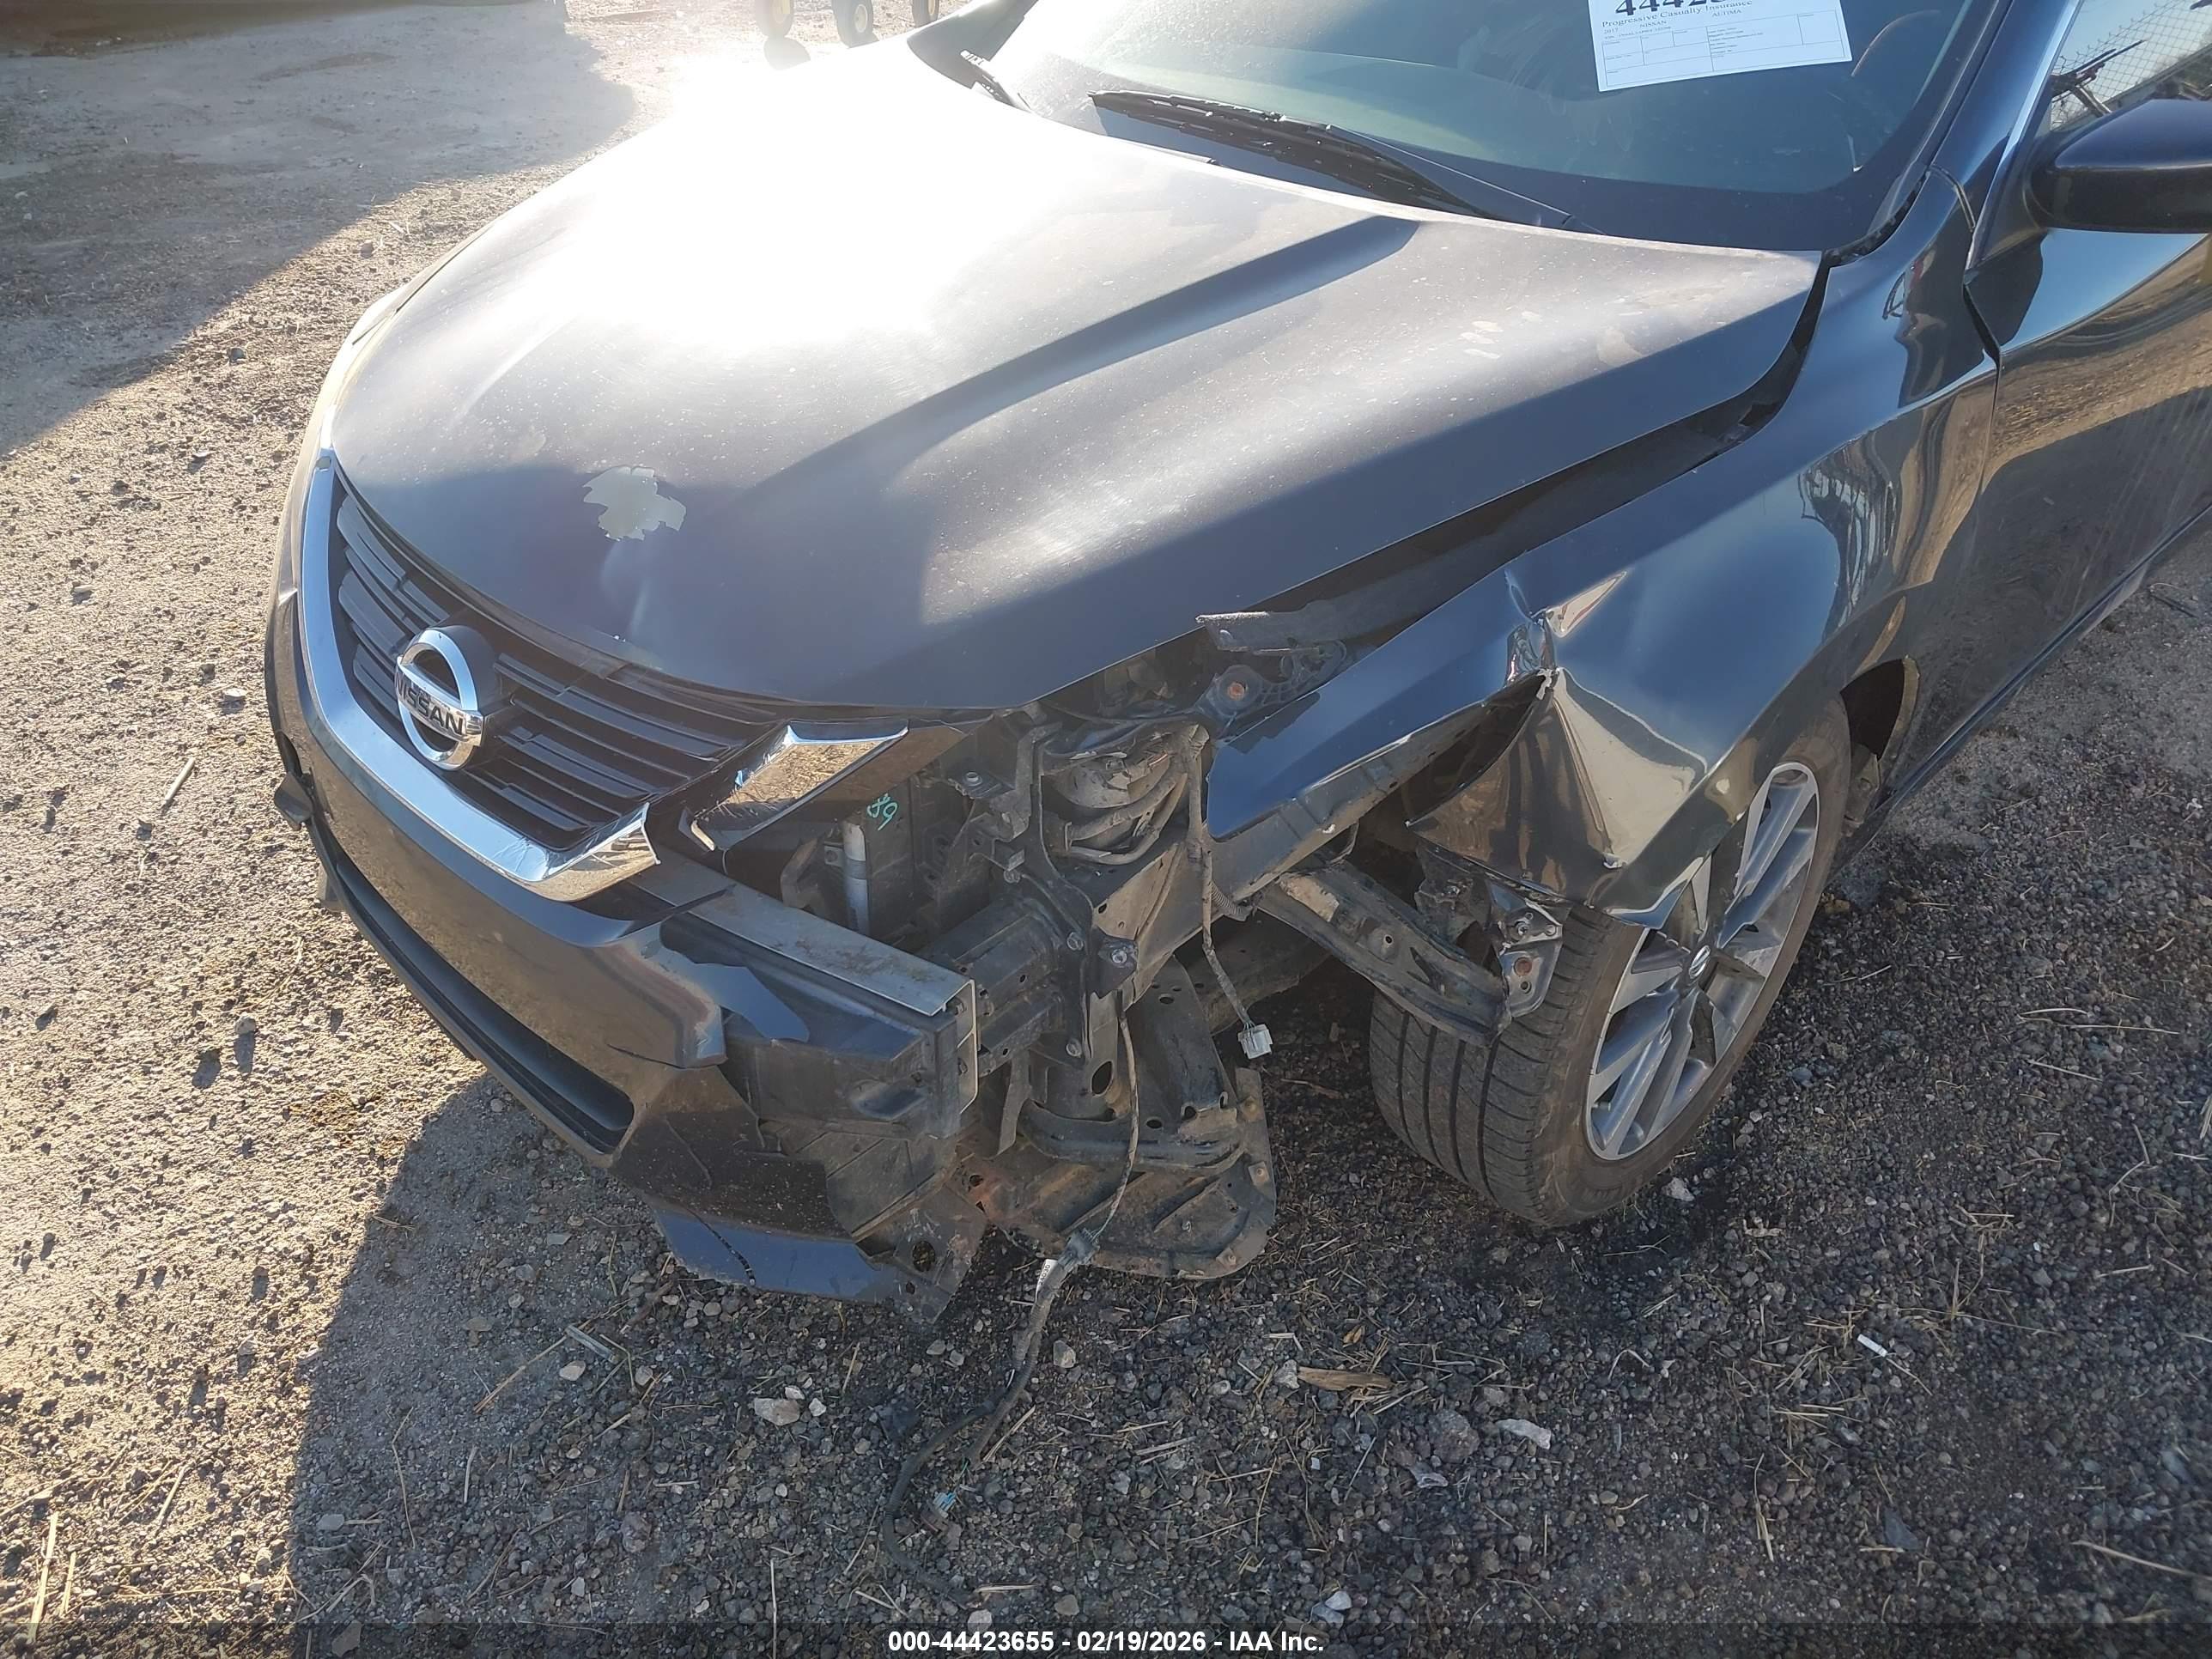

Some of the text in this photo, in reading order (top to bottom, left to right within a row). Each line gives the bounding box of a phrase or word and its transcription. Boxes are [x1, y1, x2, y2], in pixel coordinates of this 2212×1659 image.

[1601, 15, 1658, 27] Progressive
[1660, 7, 1702, 18] Casualty
[1705, 1, 1753, 11] Insurance
[395, 671, 464, 736] NISSAN
